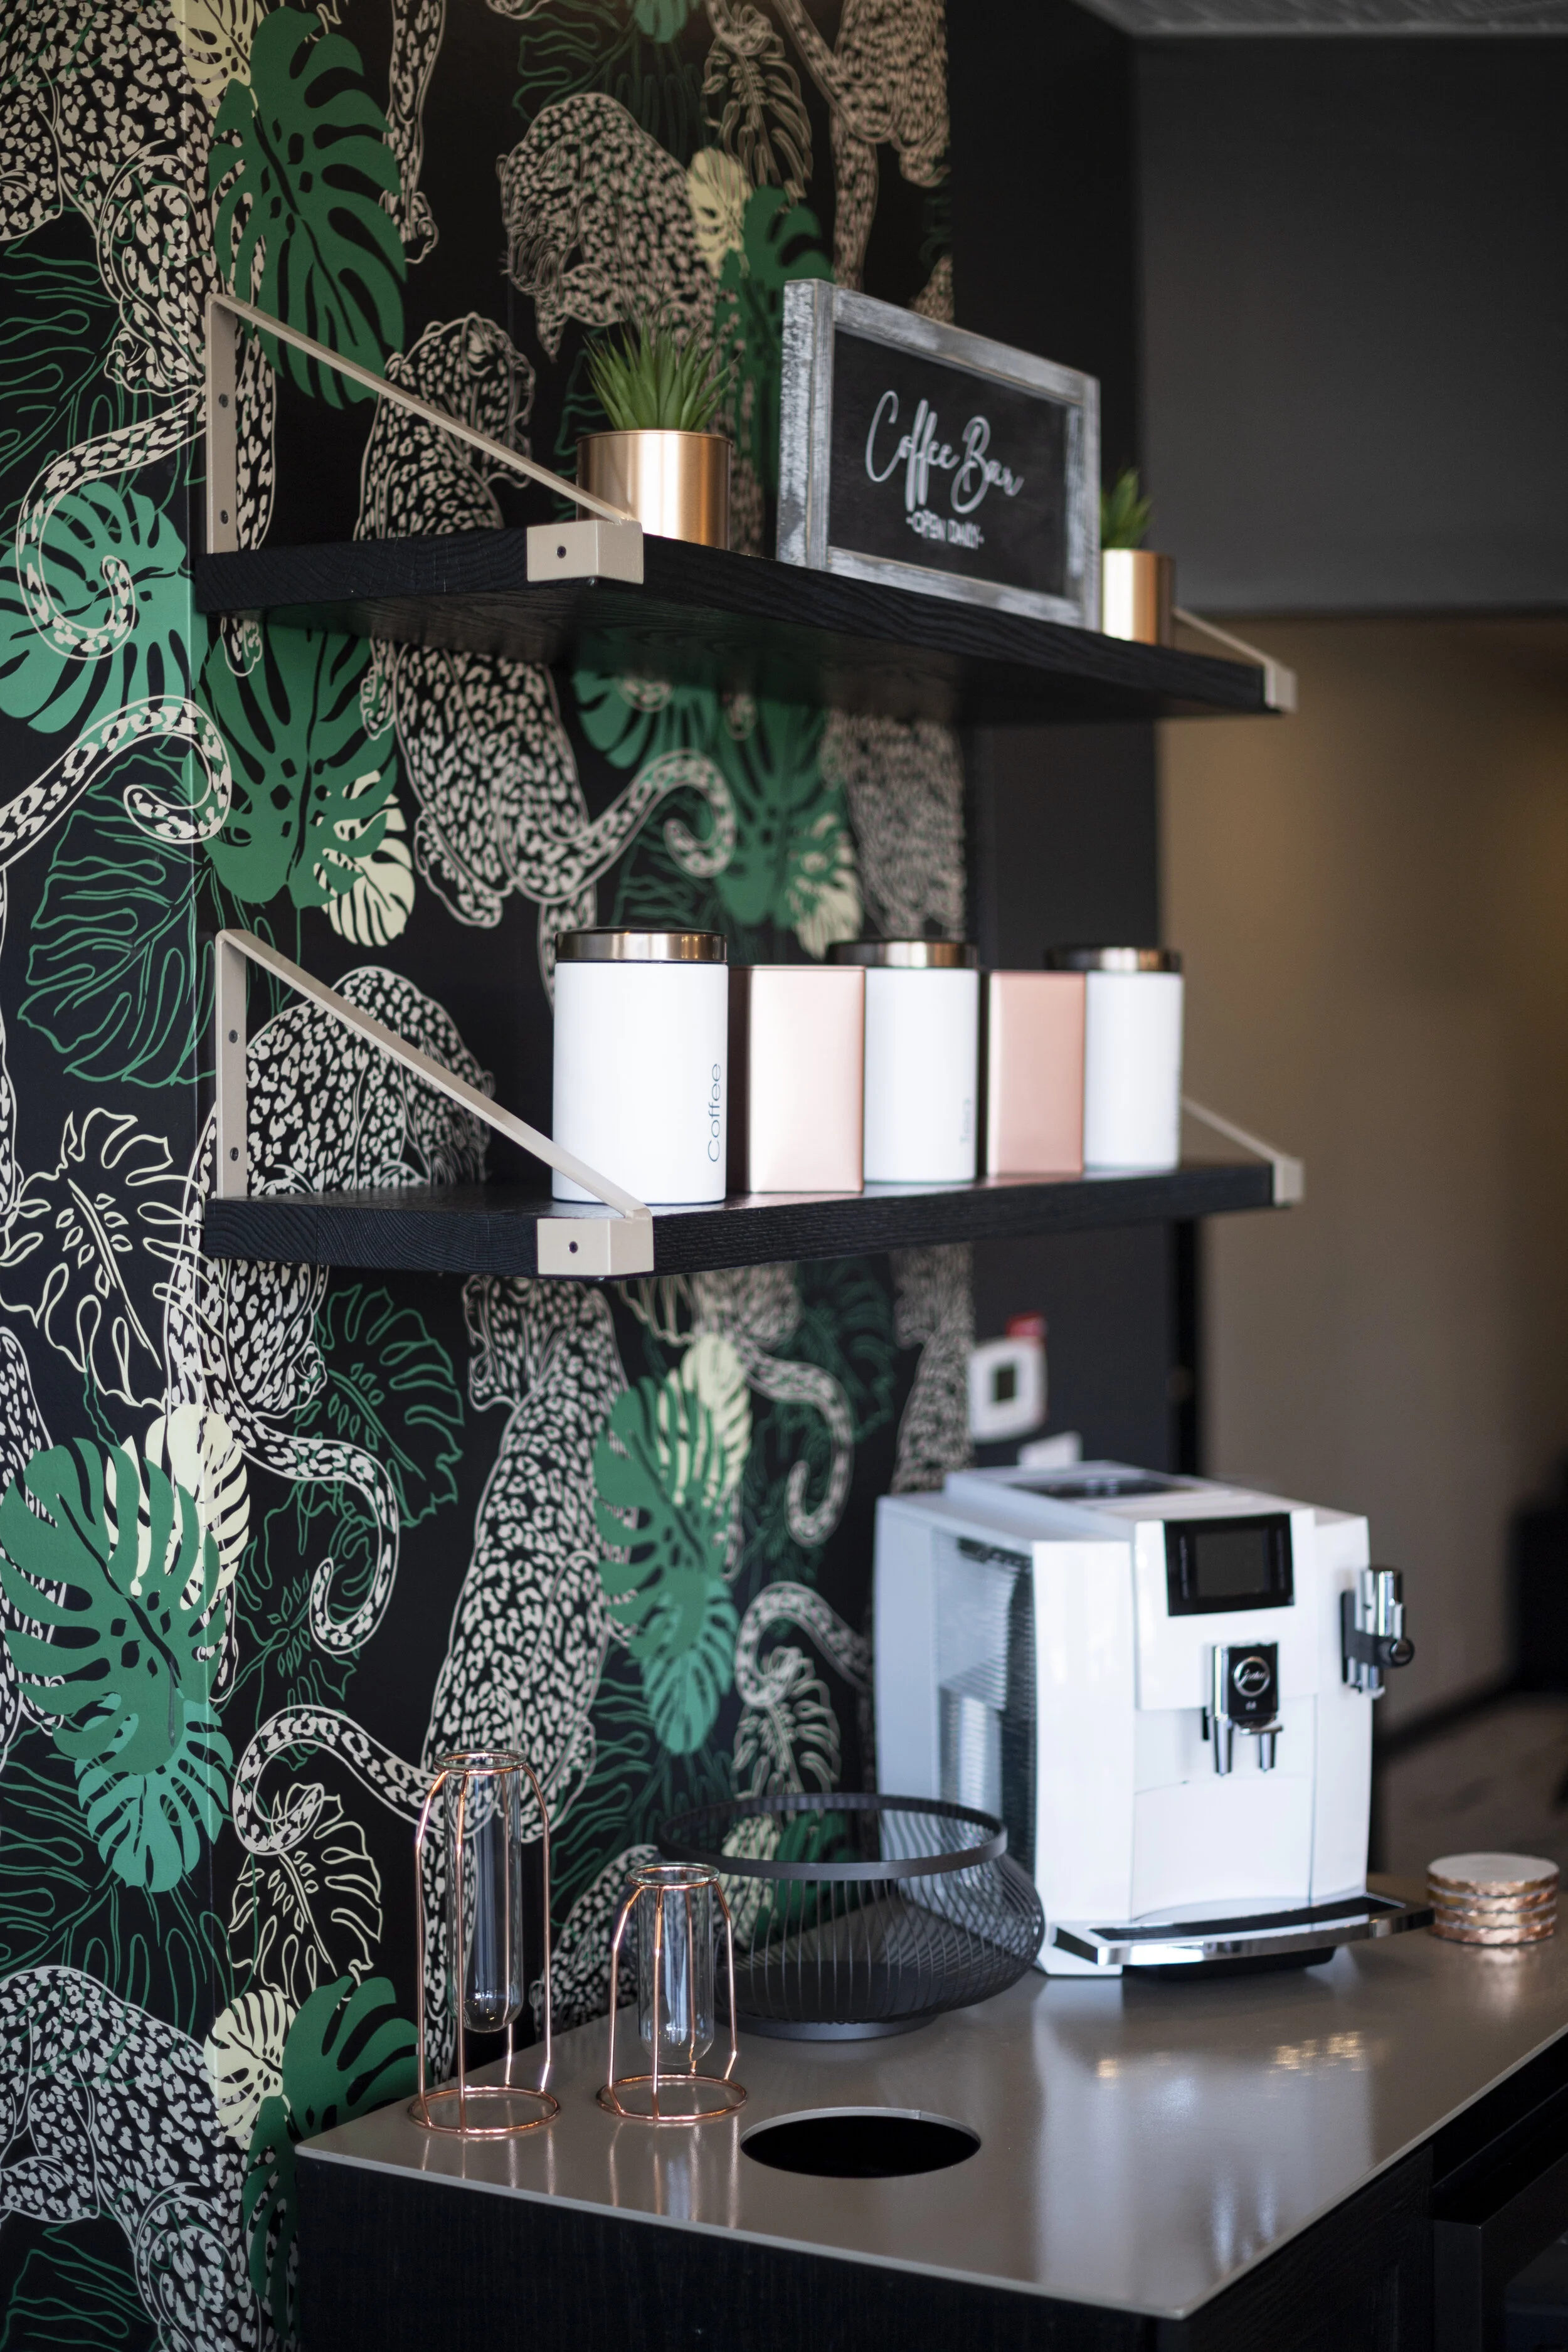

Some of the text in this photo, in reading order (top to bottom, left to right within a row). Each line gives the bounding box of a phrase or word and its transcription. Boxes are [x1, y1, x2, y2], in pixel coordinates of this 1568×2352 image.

[865, 390, 1025, 514] Coffee Bar
[911, 509, 946, 541] OPEN
[707, 1063, 721, 1162] Coffee
